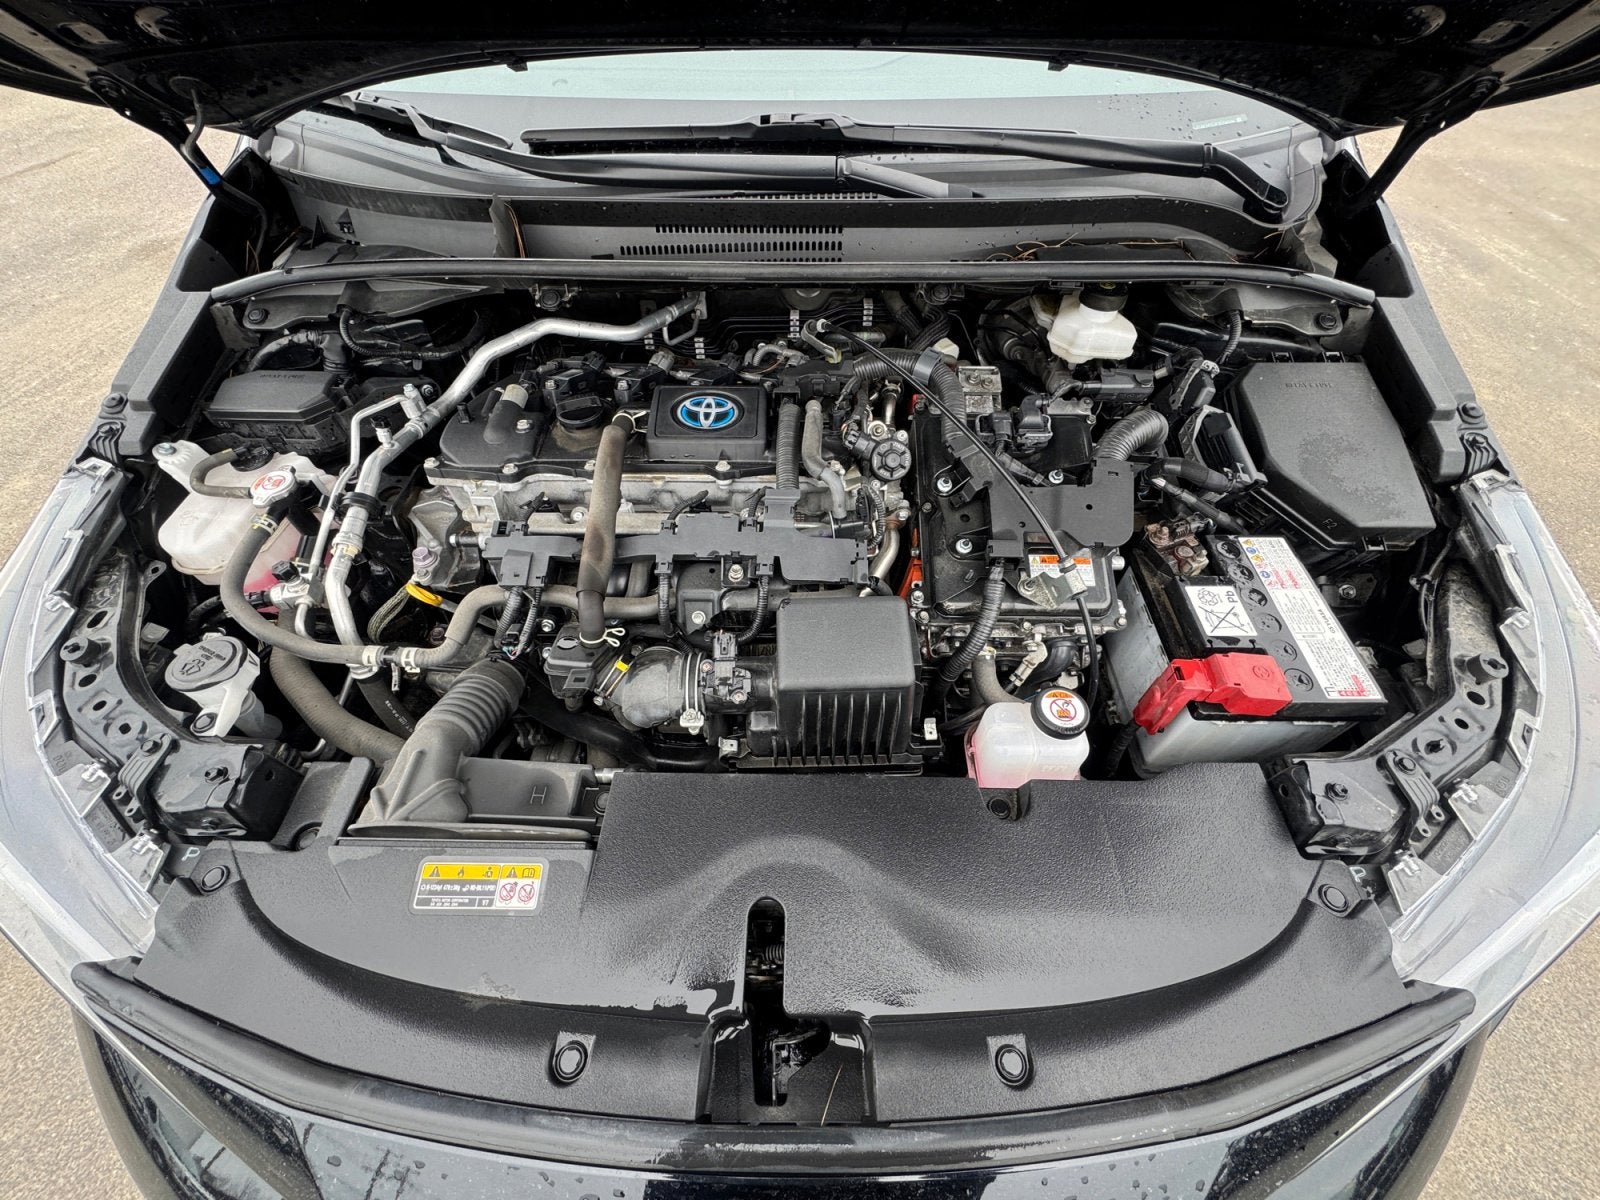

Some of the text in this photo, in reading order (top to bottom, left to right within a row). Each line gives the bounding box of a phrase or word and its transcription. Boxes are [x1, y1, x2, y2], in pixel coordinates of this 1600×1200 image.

[1223, 590, 1238, 603] Pb
[529, 785, 547, 805] H
[181, 846, 201, 862] P
[1349, 866, 1367, 882] P
